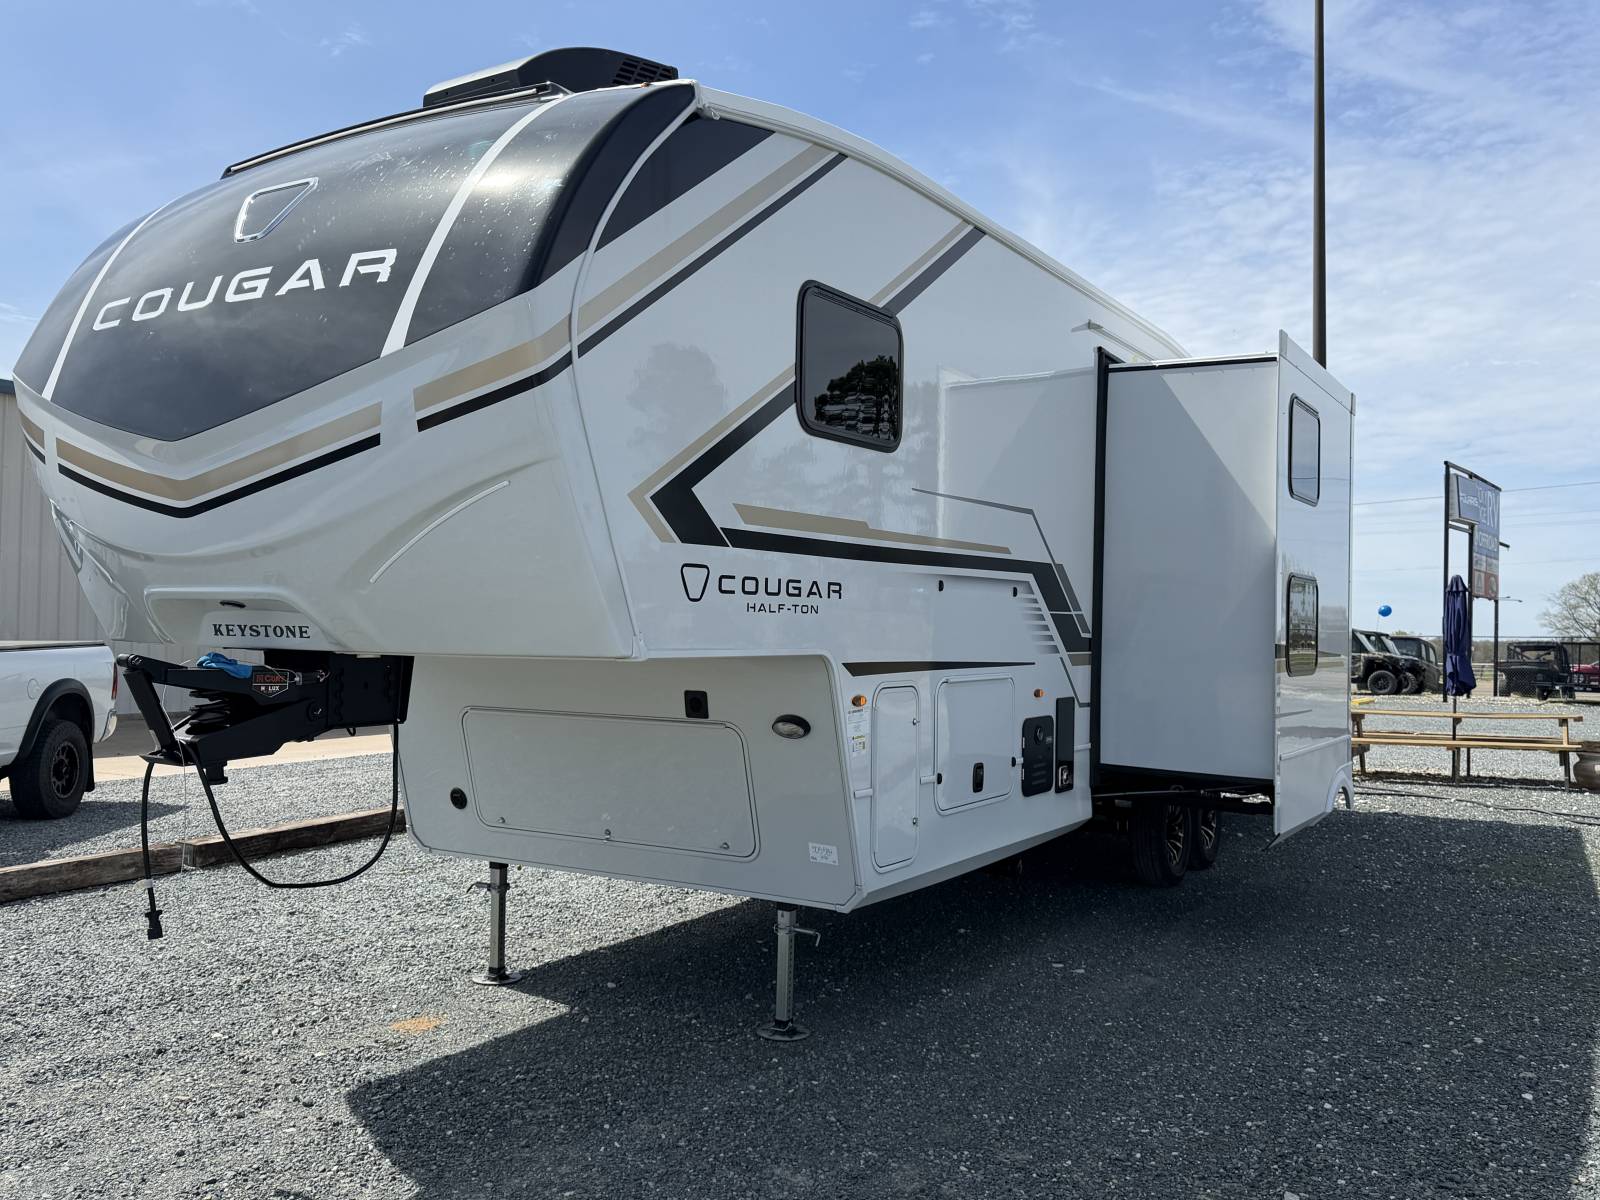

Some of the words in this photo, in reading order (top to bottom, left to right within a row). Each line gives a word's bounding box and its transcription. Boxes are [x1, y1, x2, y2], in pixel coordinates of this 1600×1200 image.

[92, 248, 397, 331] COUGAR
[717, 574, 843, 600] COUGAR
[746, 602, 819, 614] HALF-TON
[212, 623, 311, 639] KEYSTONE
